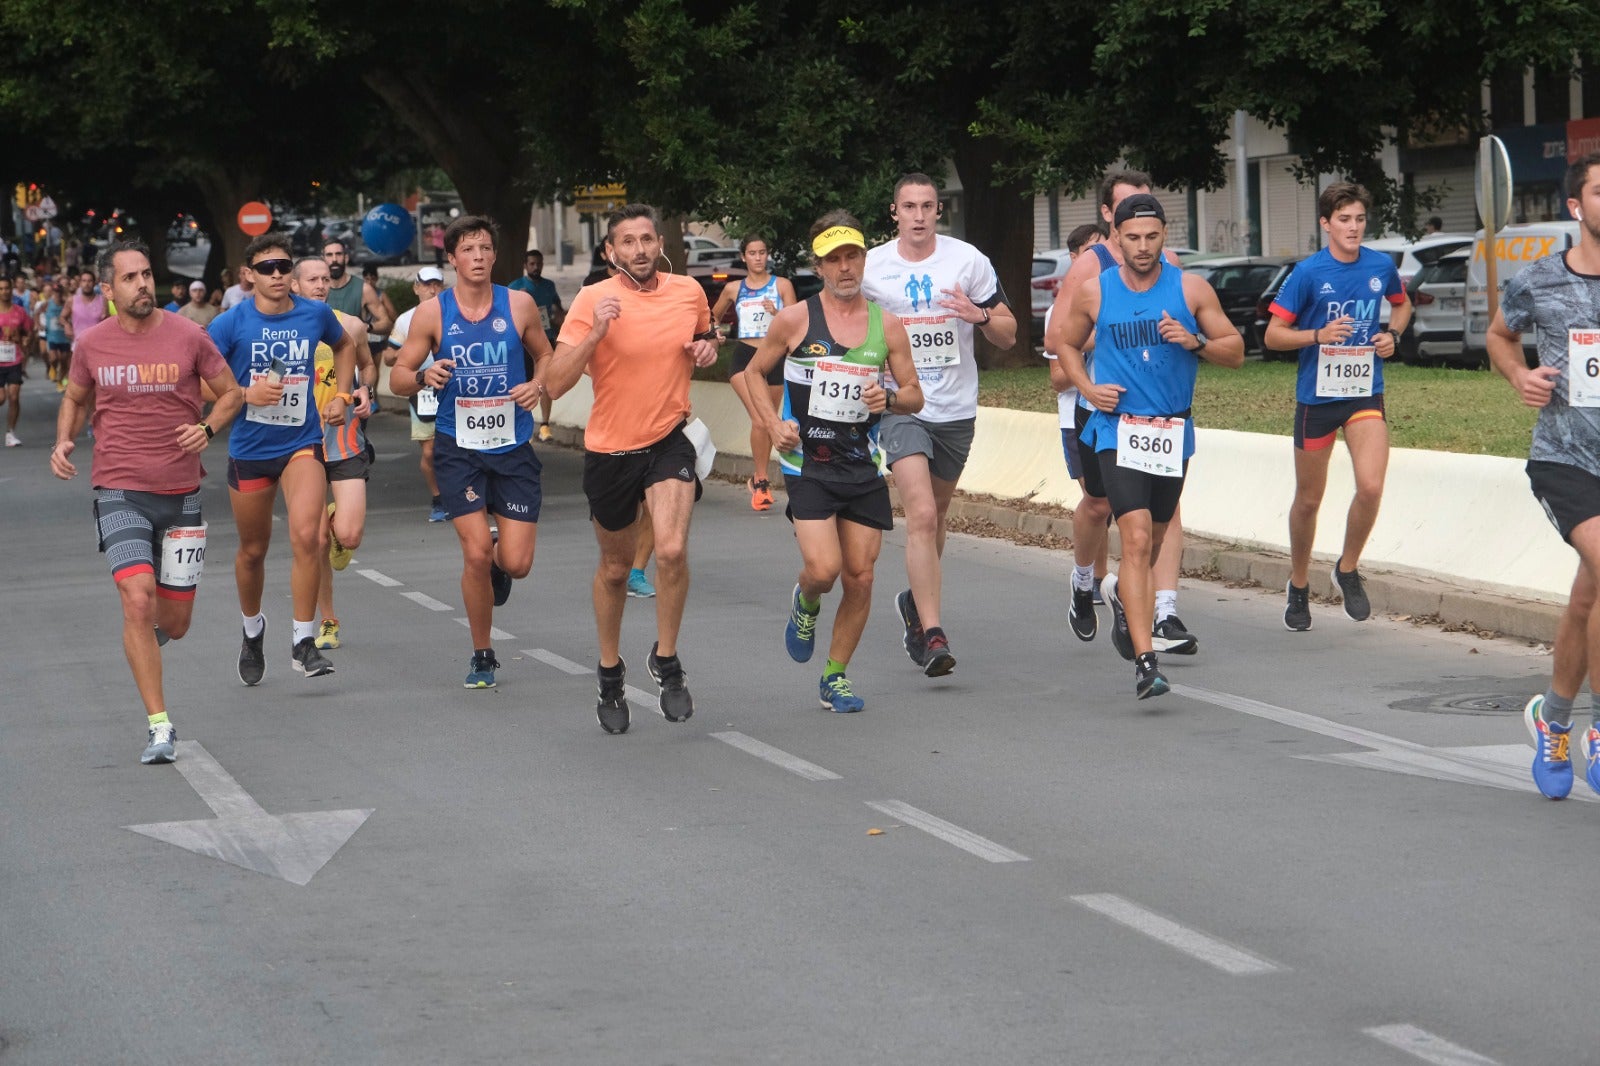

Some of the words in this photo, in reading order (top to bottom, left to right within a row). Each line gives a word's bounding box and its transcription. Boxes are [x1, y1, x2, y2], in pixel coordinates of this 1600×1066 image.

[752, 312, 765, 322] 27
[262, 327, 298, 341] Remo
[911, 331, 954, 348] 3968
[1108, 317, 1177, 350] THUND
[251, 339, 310, 362] RCM
[451, 341, 508, 367] RCM
[98, 363, 179, 387] INFOWOD
[1324, 363, 1370, 378] 11802
[127, 385, 154, 393] REVISTA
[456, 374, 508, 395] 1873
[466, 413, 506, 430] 6490
[1129, 434, 1173, 455] 6360
